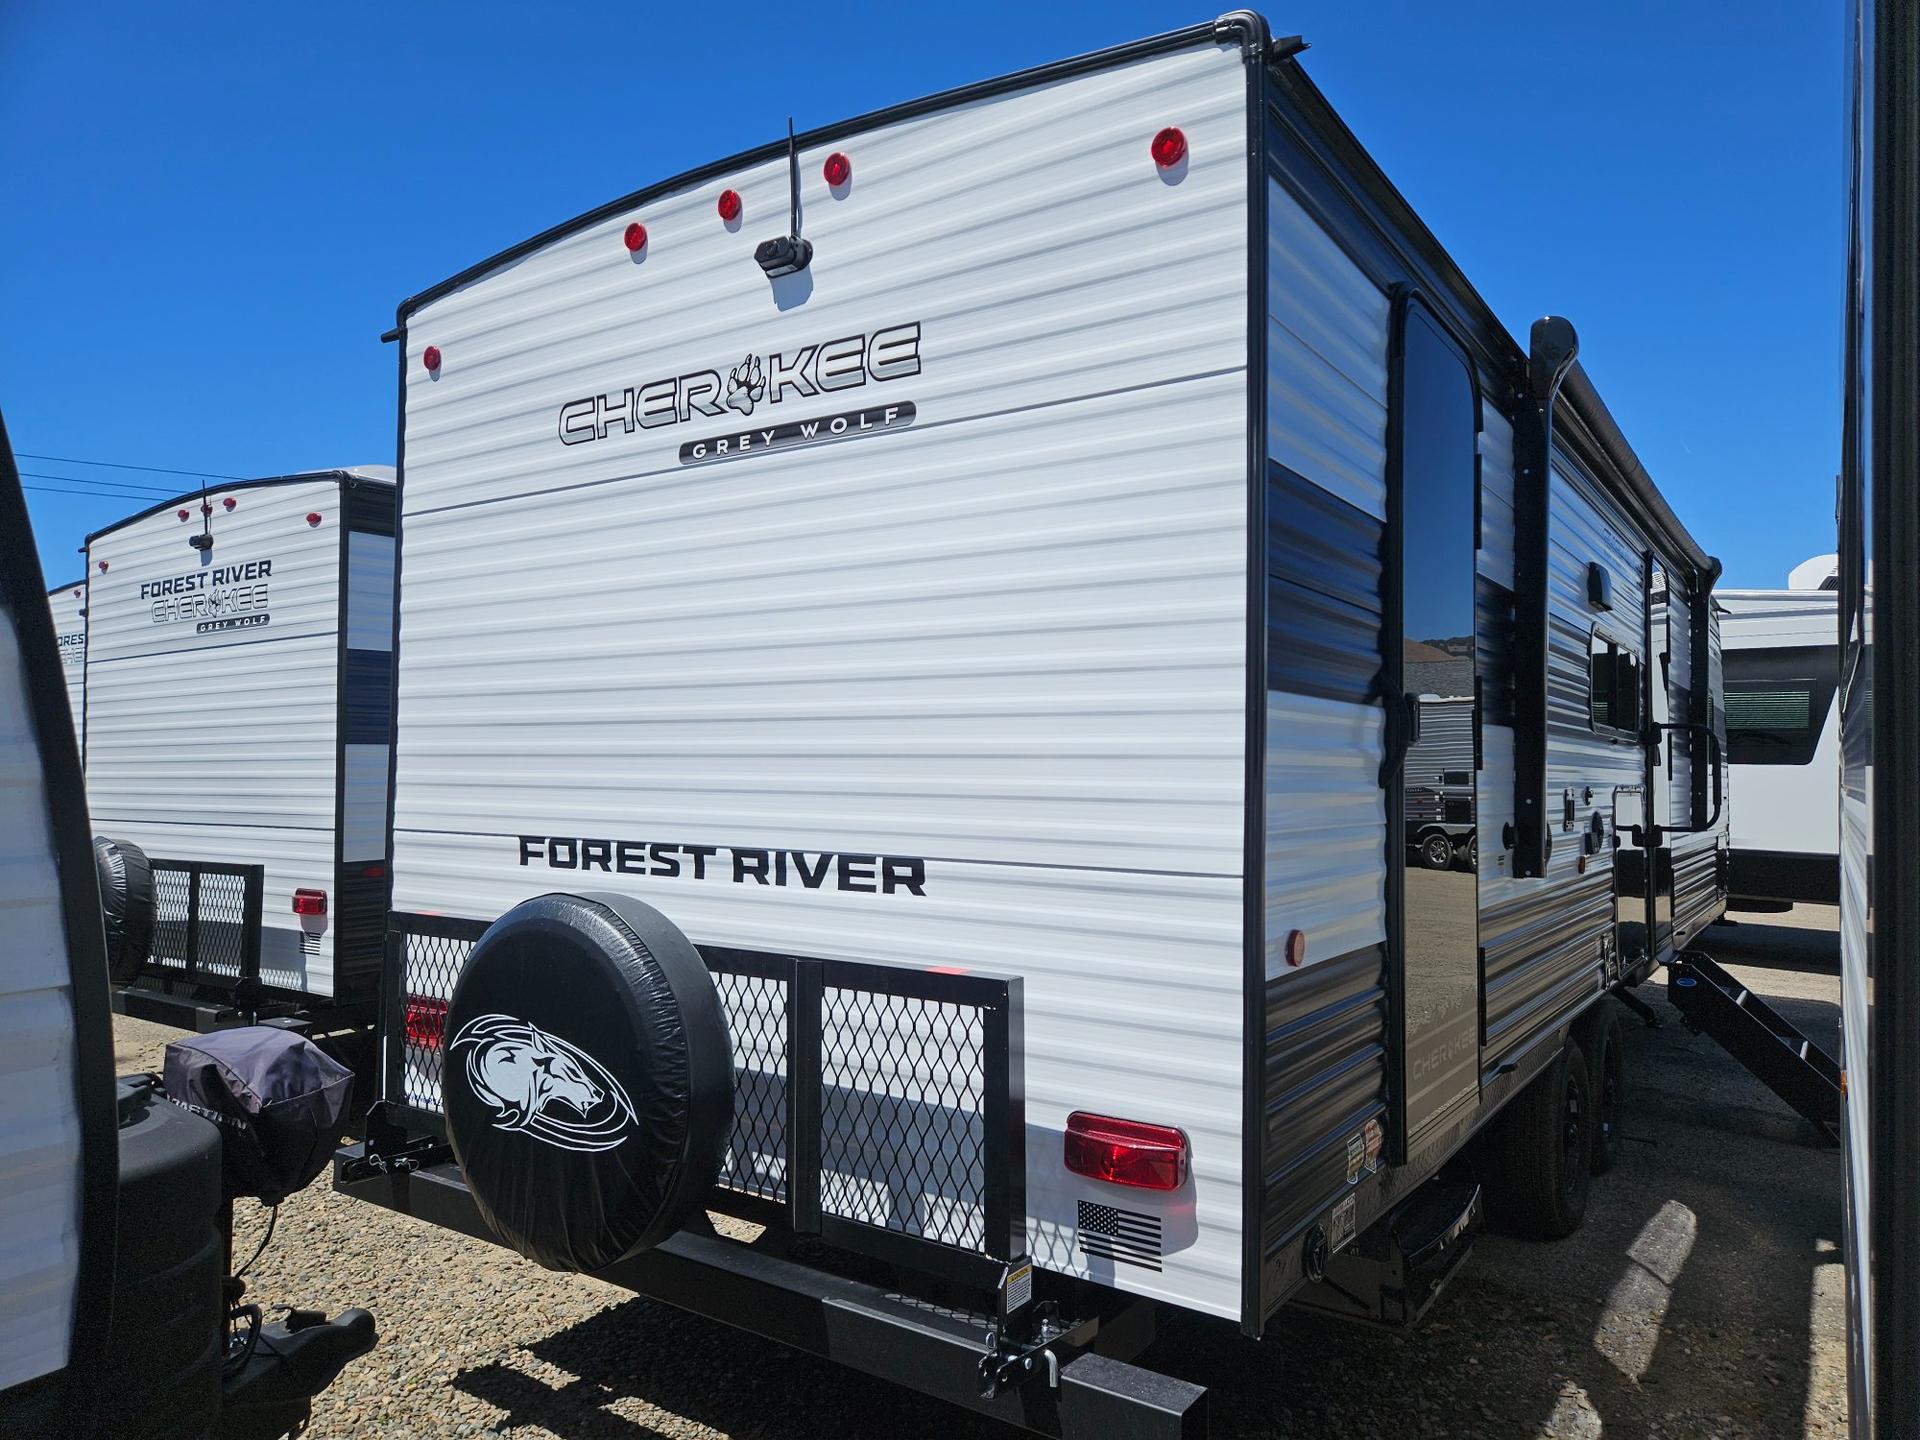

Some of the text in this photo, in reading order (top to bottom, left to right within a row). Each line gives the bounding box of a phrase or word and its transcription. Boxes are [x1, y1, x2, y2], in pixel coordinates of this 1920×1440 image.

[692, 406, 899, 459] GREY WOLF
[140, 560, 272, 600] FOREST RIVER
[57, 633, 84, 647] ORES
[200, 615, 266, 632] GREY WOLF
[517, 835, 928, 897] FOREST RIVER
